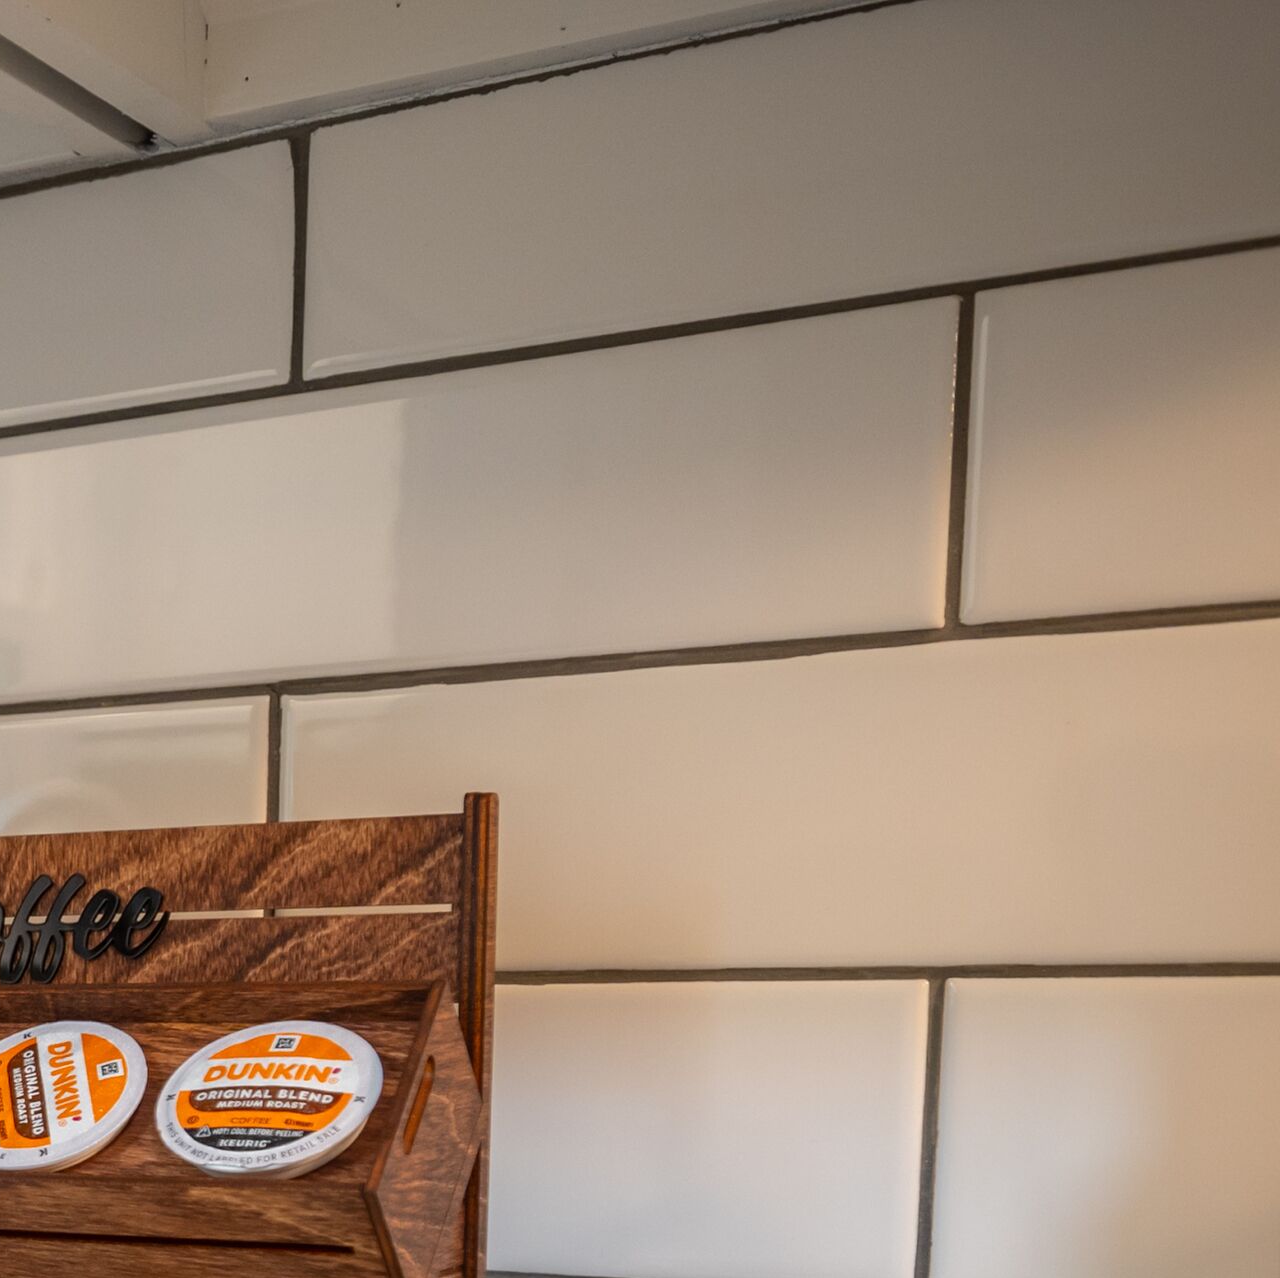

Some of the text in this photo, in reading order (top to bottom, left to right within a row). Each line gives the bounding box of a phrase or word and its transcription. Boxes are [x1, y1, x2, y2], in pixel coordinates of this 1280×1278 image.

[203, 1062, 342, 1083] DUNKIN'
[12, 1067, 28, 1124] MEDIUM ROAST
[22, 1050, 44, 1135] ORIGINAL BLEND
[195, 1088, 334, 1104] ORIGINAL BLEND
[216, 1100, 307, 1109] MEDIUM ROAST
[219, 1139, 268, 1148] KEURIG
[257, 1153, 277, 1163] FOR
[280, 1140, 316, 1159] RETAIL
[316, 1125, 343, 1143] SALE
